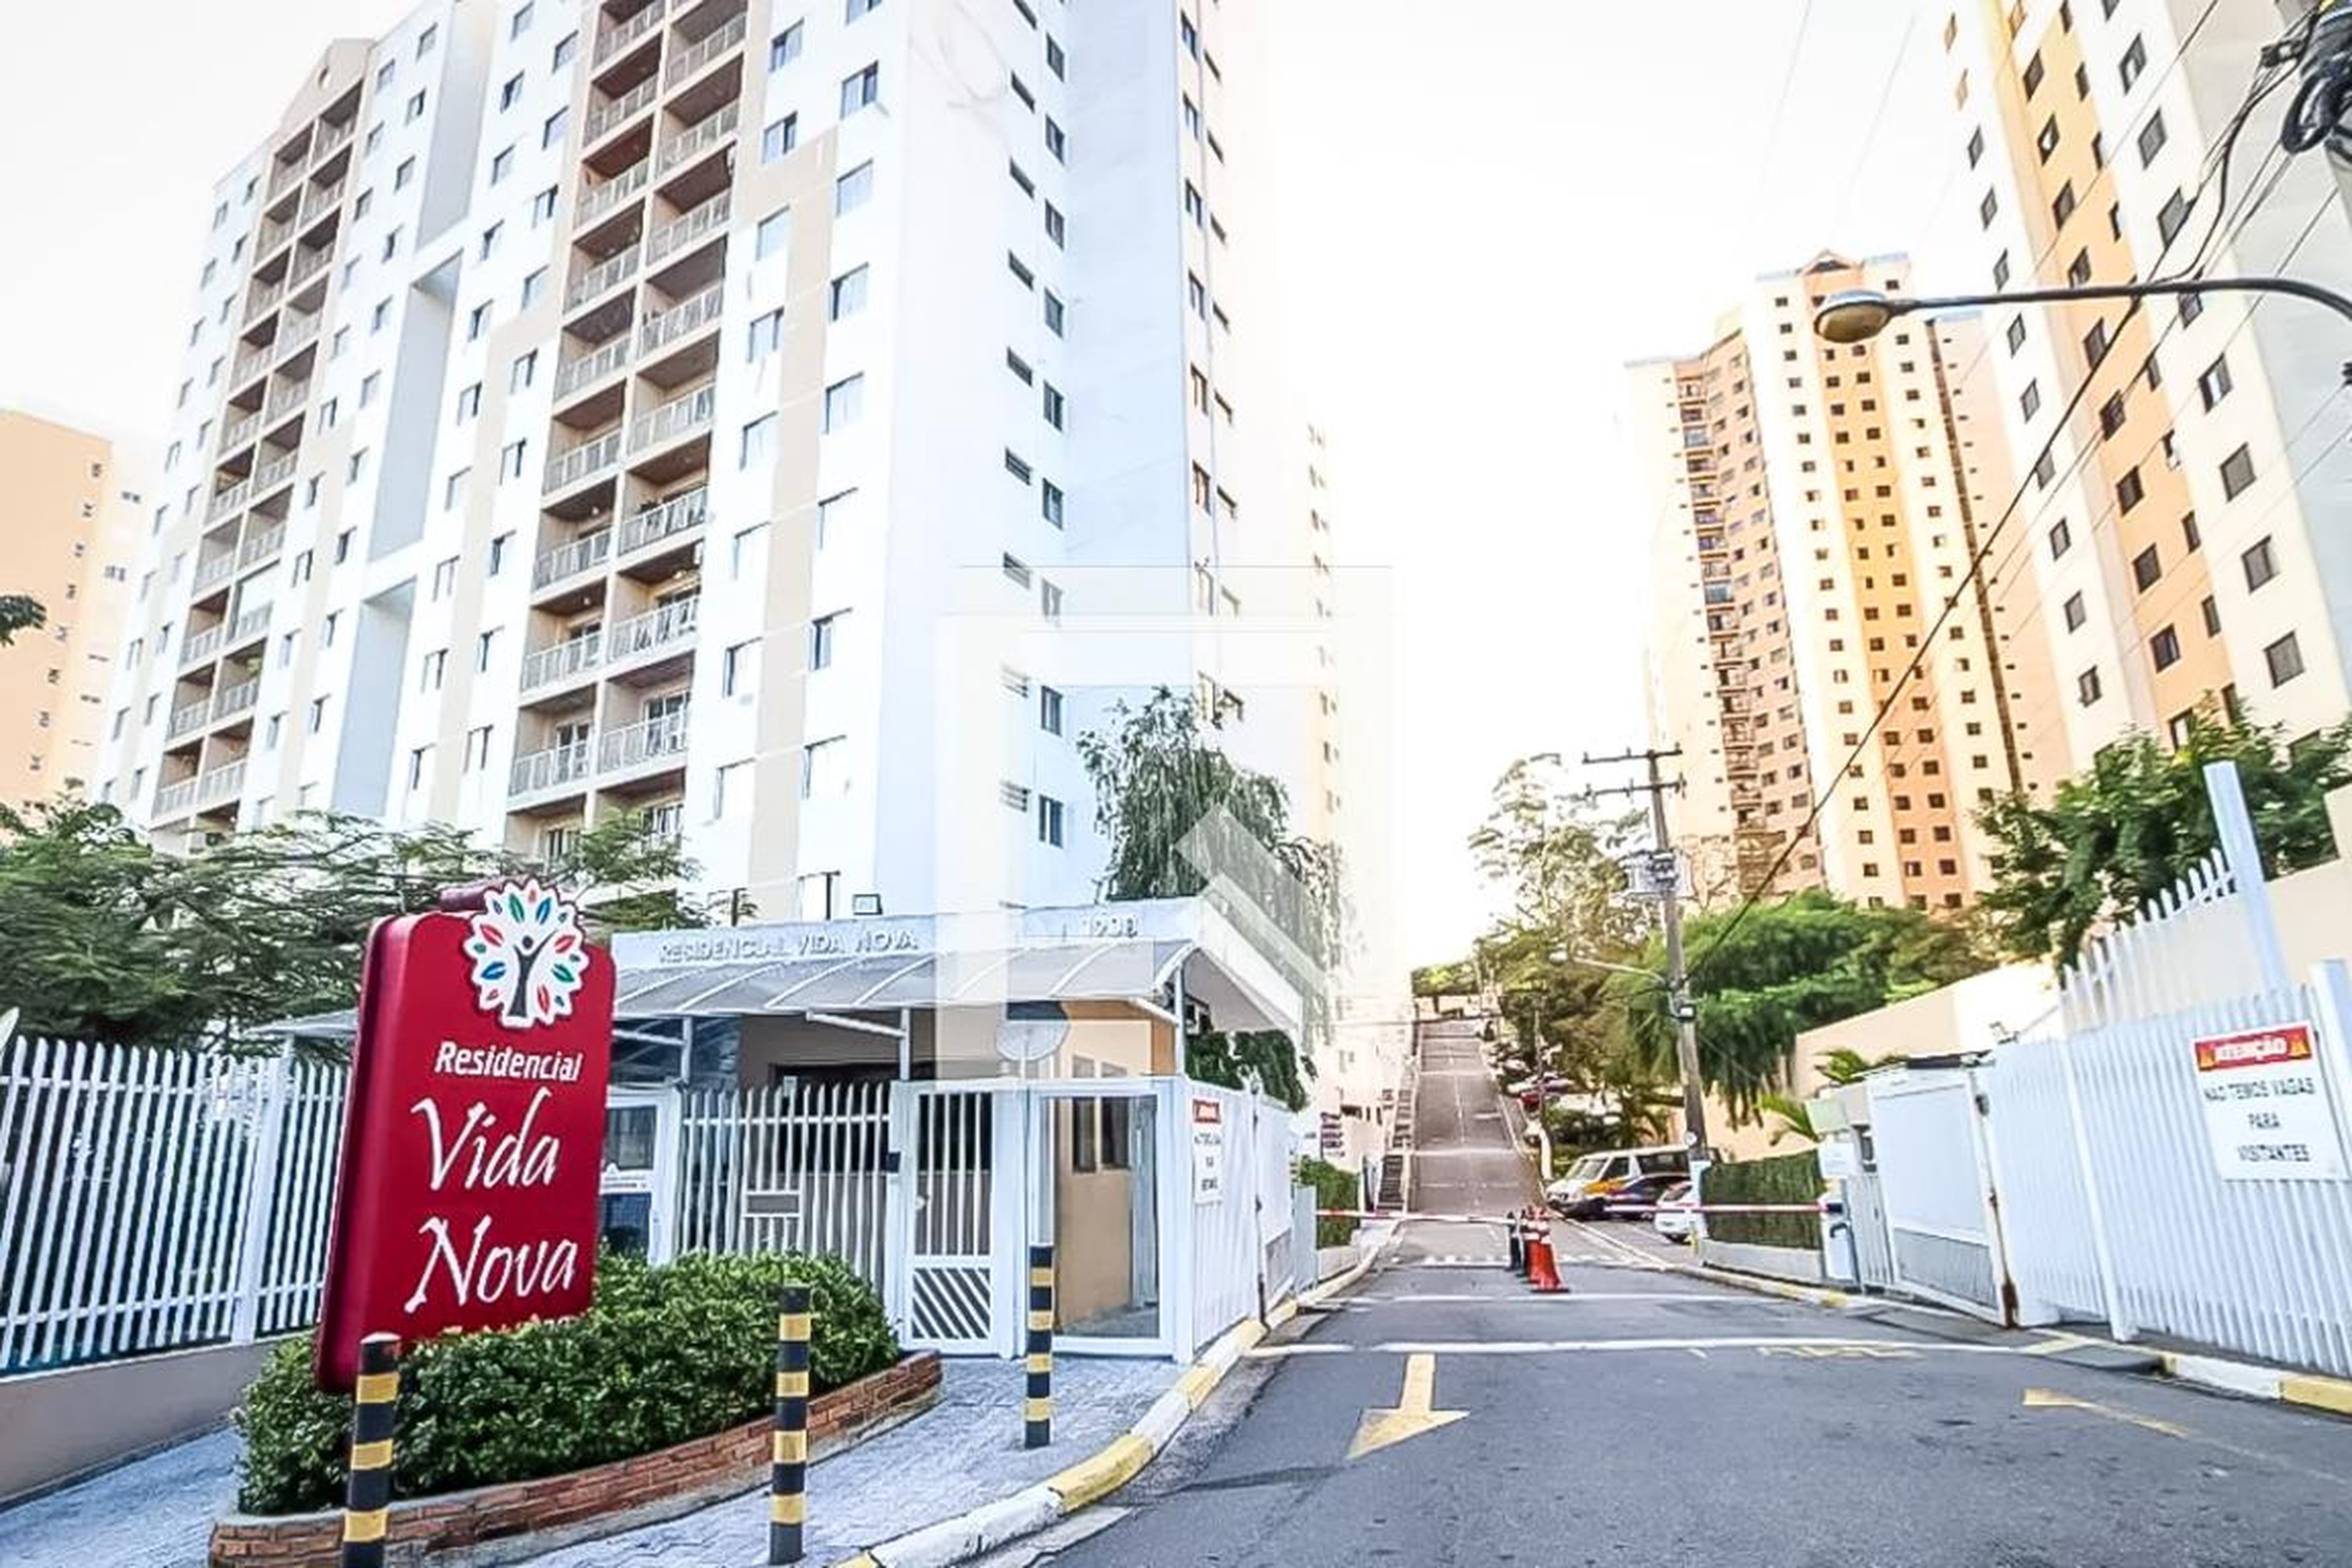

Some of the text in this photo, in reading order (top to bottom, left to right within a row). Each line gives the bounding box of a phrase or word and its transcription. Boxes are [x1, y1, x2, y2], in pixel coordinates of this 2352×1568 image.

[658, 929, 919, 963] RESIDENCIAL VIDA NOVA
[434, 1041, 583, 1082] Residencial
[410, 1087, 560, 1190] Vida
[2247, 1112, 2281, 1129] PARA
[2237, 1143, 2311, 1163] VISITANTES
[404, 1215, 578, 1314] Nova
